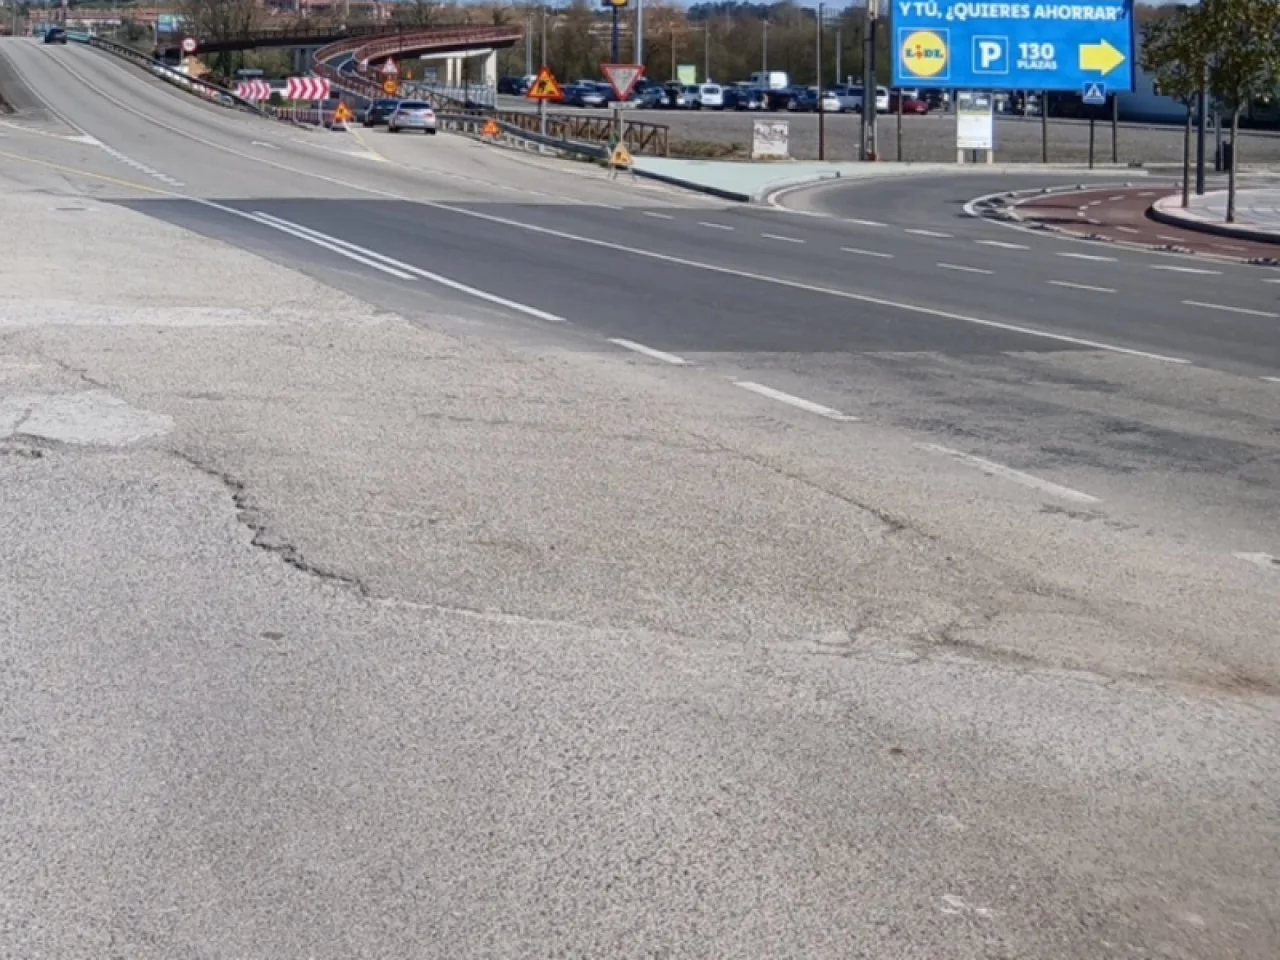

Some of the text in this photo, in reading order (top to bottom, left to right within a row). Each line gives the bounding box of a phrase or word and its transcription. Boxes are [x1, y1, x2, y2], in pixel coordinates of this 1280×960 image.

[898, 1, 911, 16] Y
[945, 4, 1031, 21] ¿QUIERES
[978, 41, 1002, 69] P
[1018, 42, 1055, 60] 130
